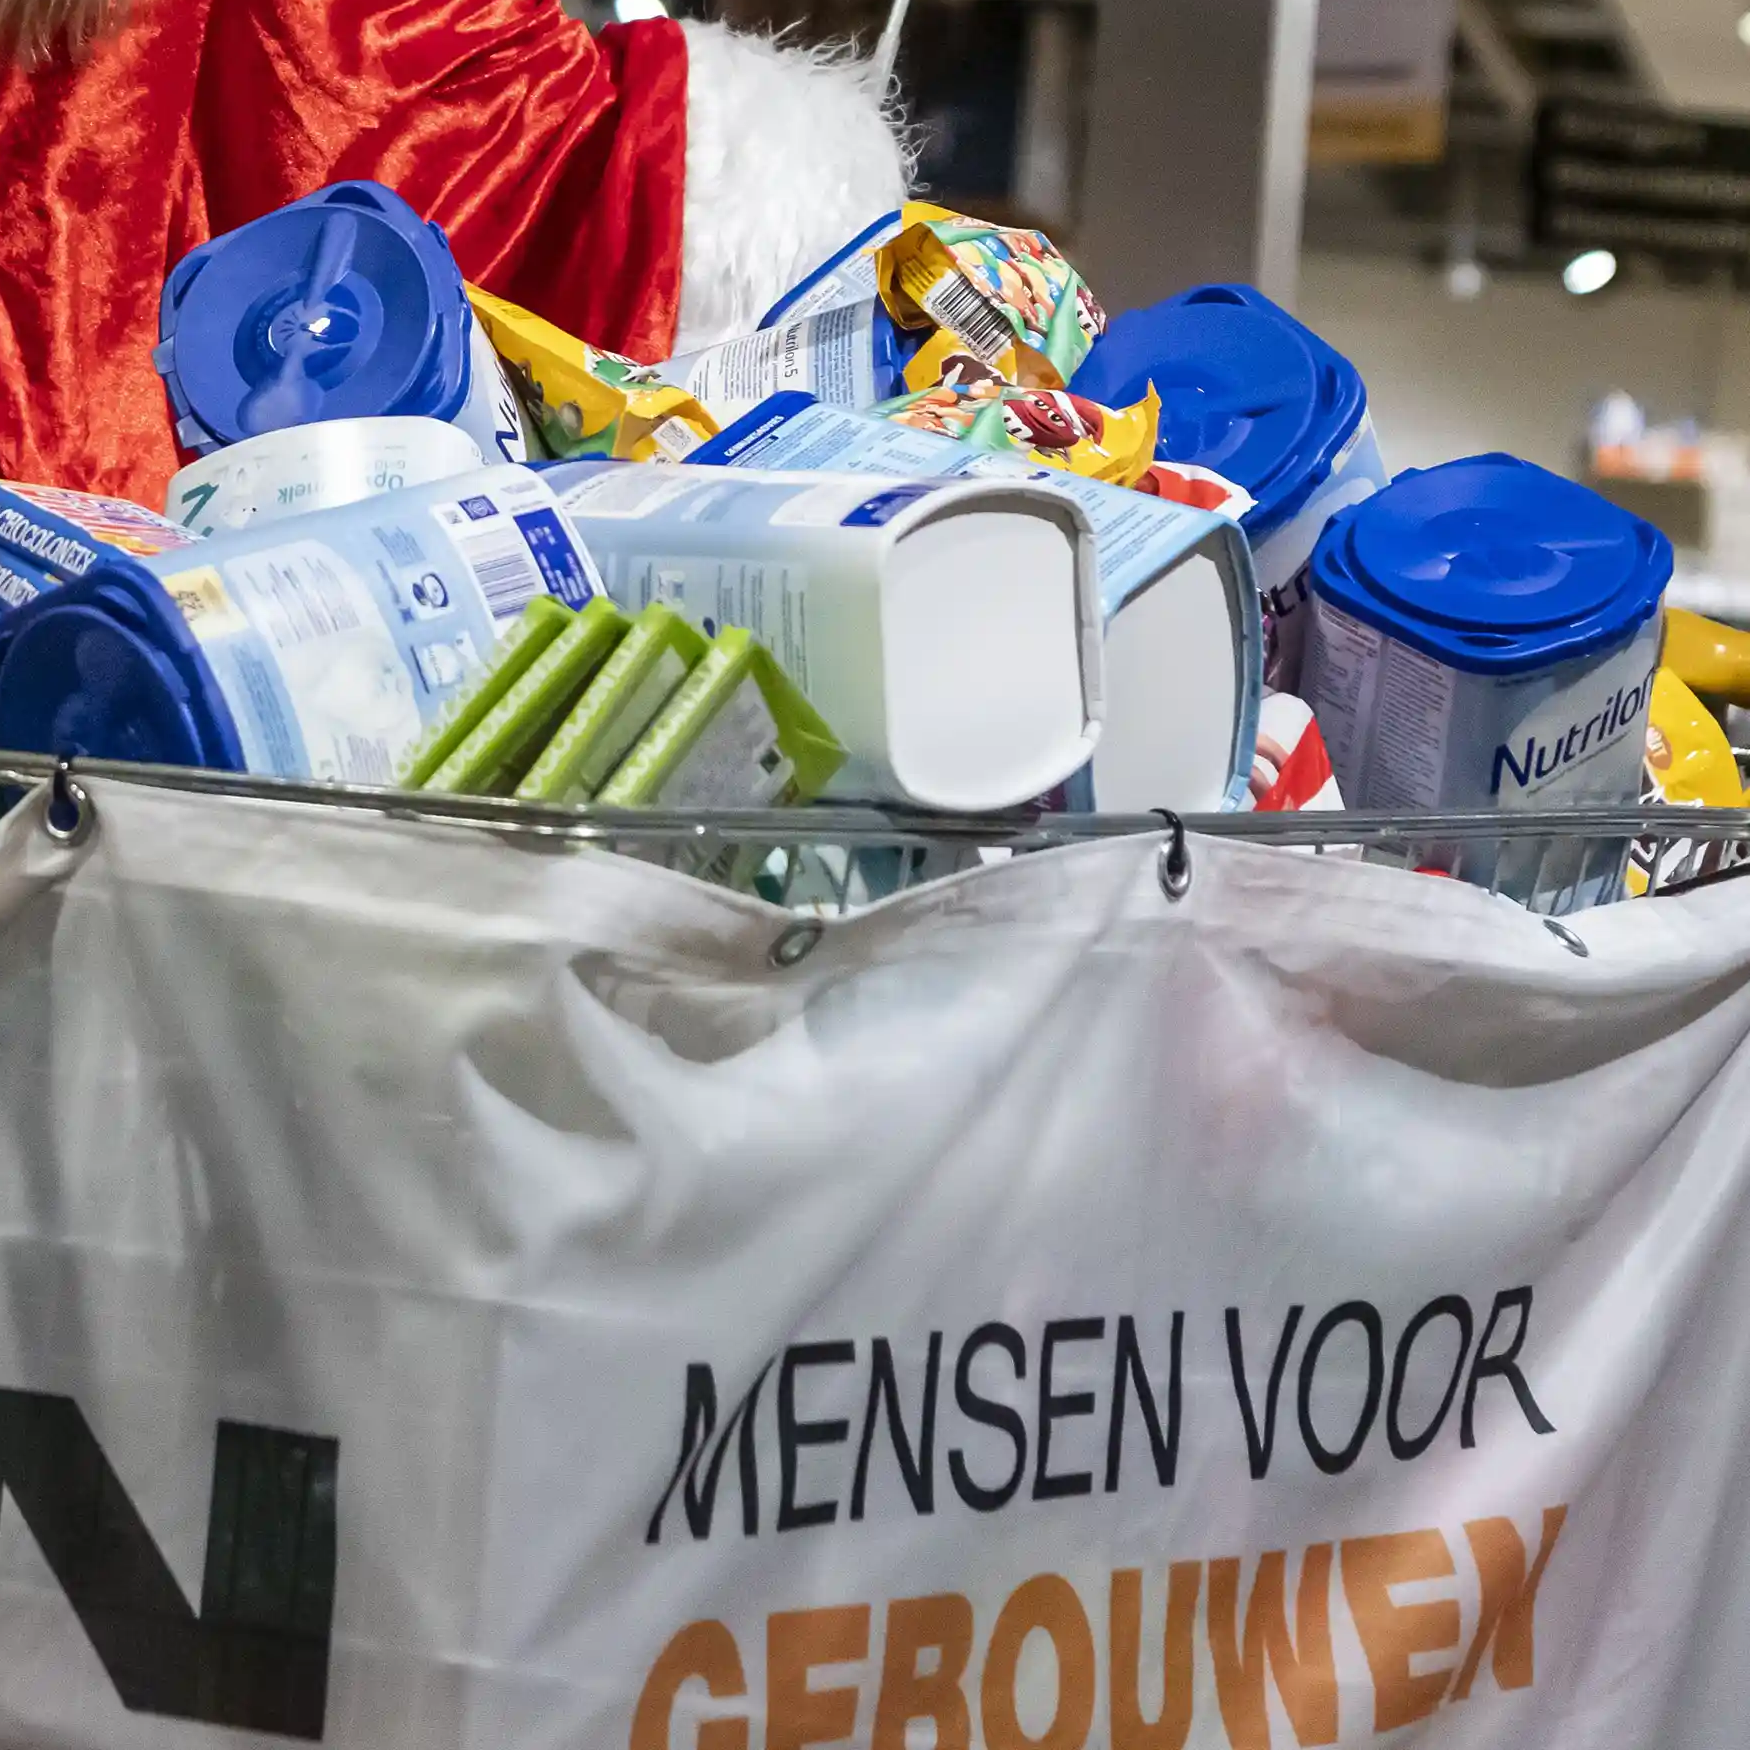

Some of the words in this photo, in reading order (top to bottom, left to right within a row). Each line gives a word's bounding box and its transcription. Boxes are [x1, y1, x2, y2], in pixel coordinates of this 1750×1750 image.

[785, 368, 798, 378] 5
[645, 1310, 1186, 1545] MENSEN
[1225, 1285, 1558, 1481] VOOR
[629, 1503, 1570, 1750] GEBOUWEN
